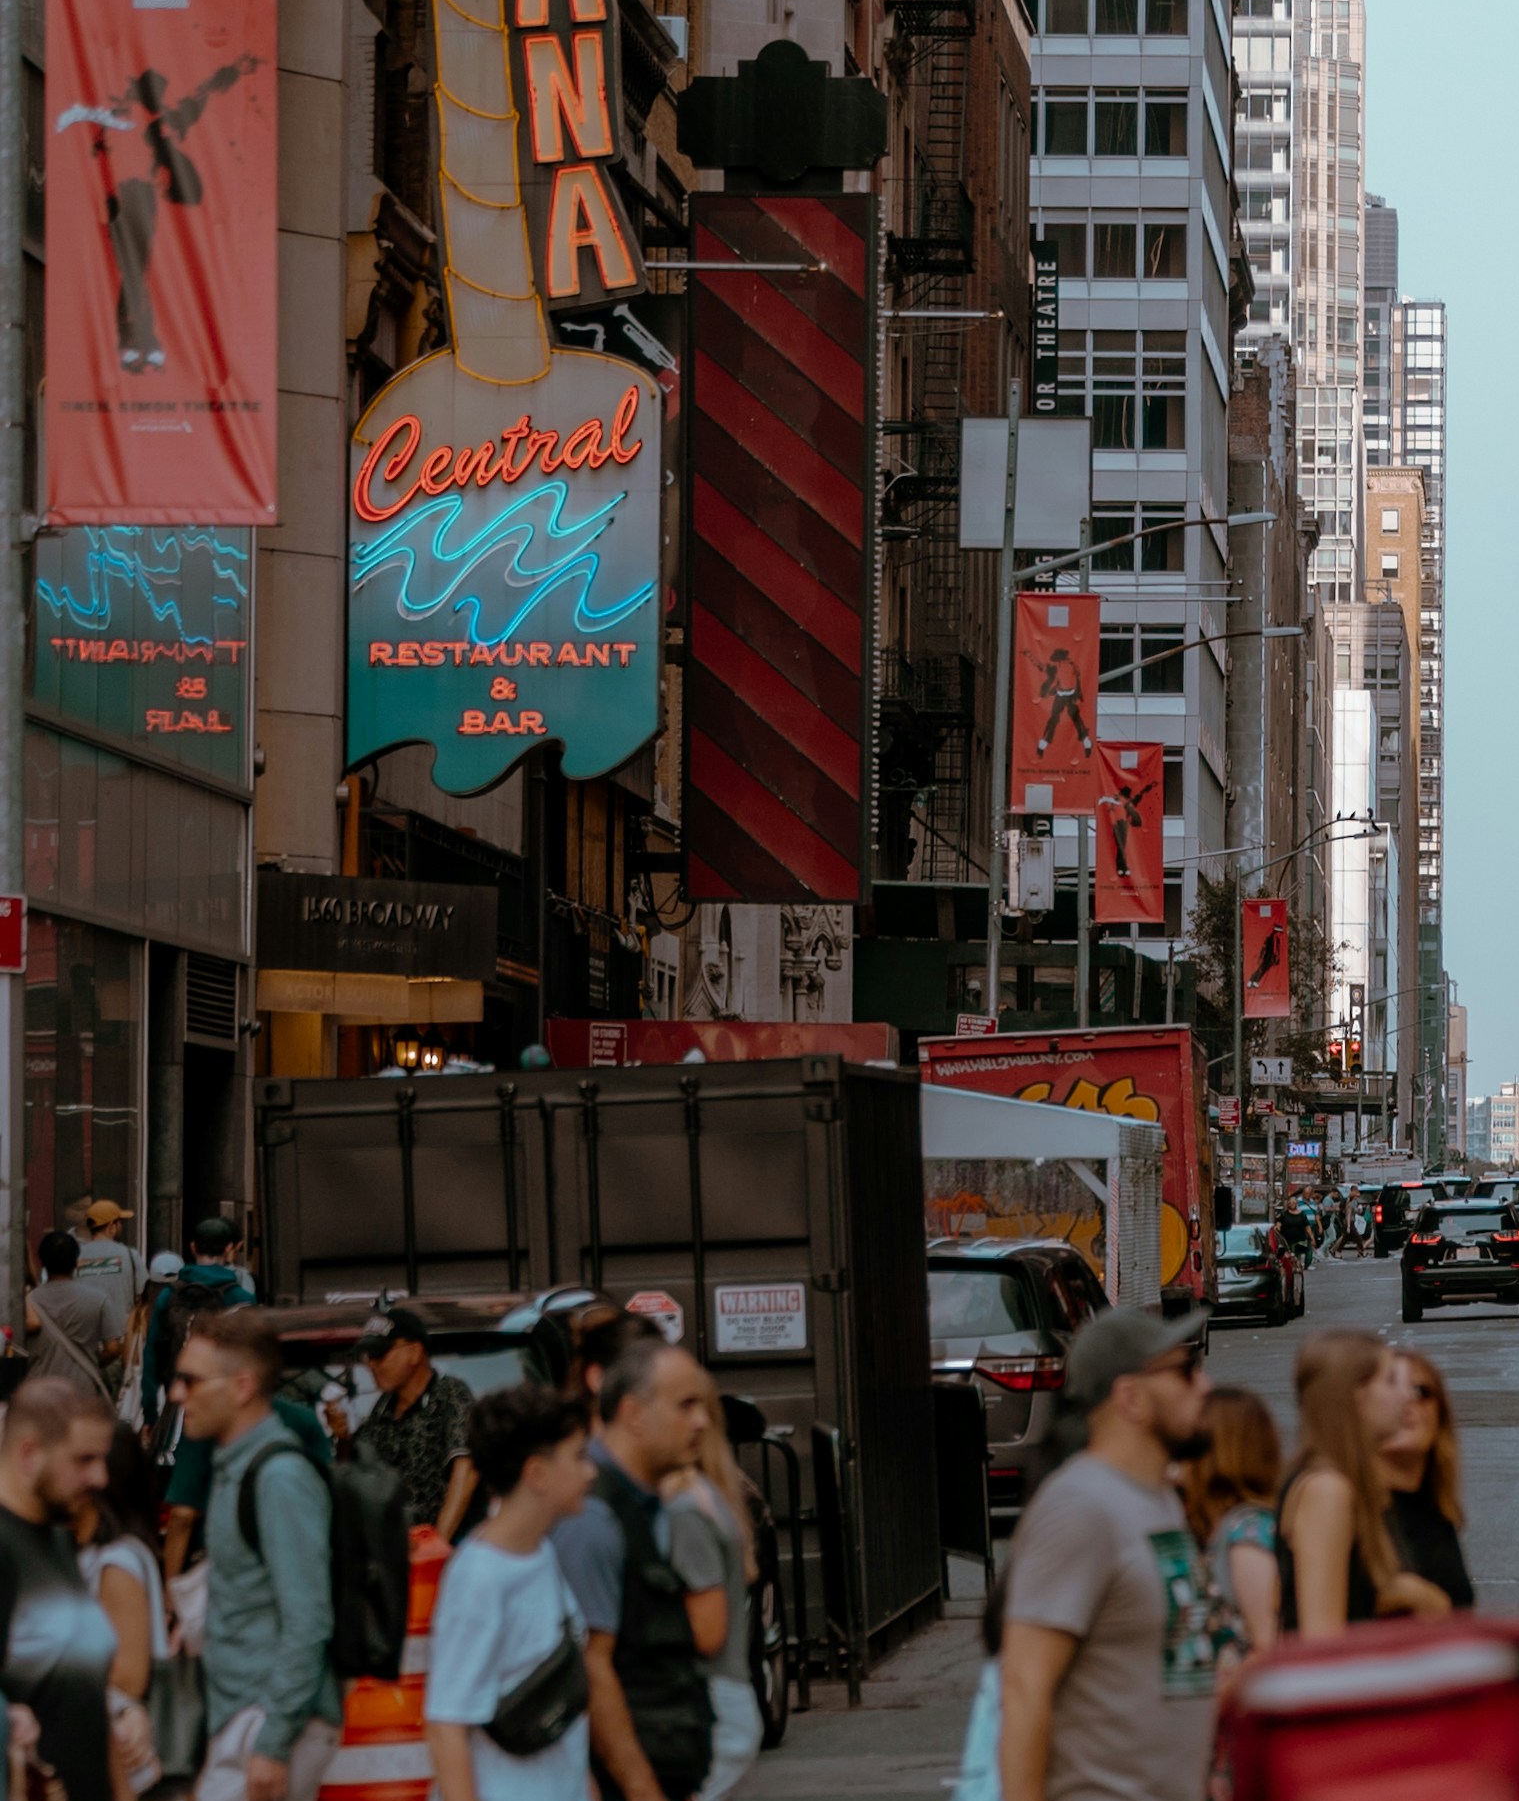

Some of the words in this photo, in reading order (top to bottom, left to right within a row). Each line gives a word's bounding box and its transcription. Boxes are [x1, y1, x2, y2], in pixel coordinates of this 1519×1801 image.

[1036, 261, 1057, 360] THEATRE
[353, 385, 642, 522] Central
[368, 641, 637, 667] RESTAURANT
[489, 676, 518, 700] &
[457, 709, 548, 735] BAR
[346, 899, 455, 931] BROADWAY
[722, 1291, 800, 1314] WARNING
